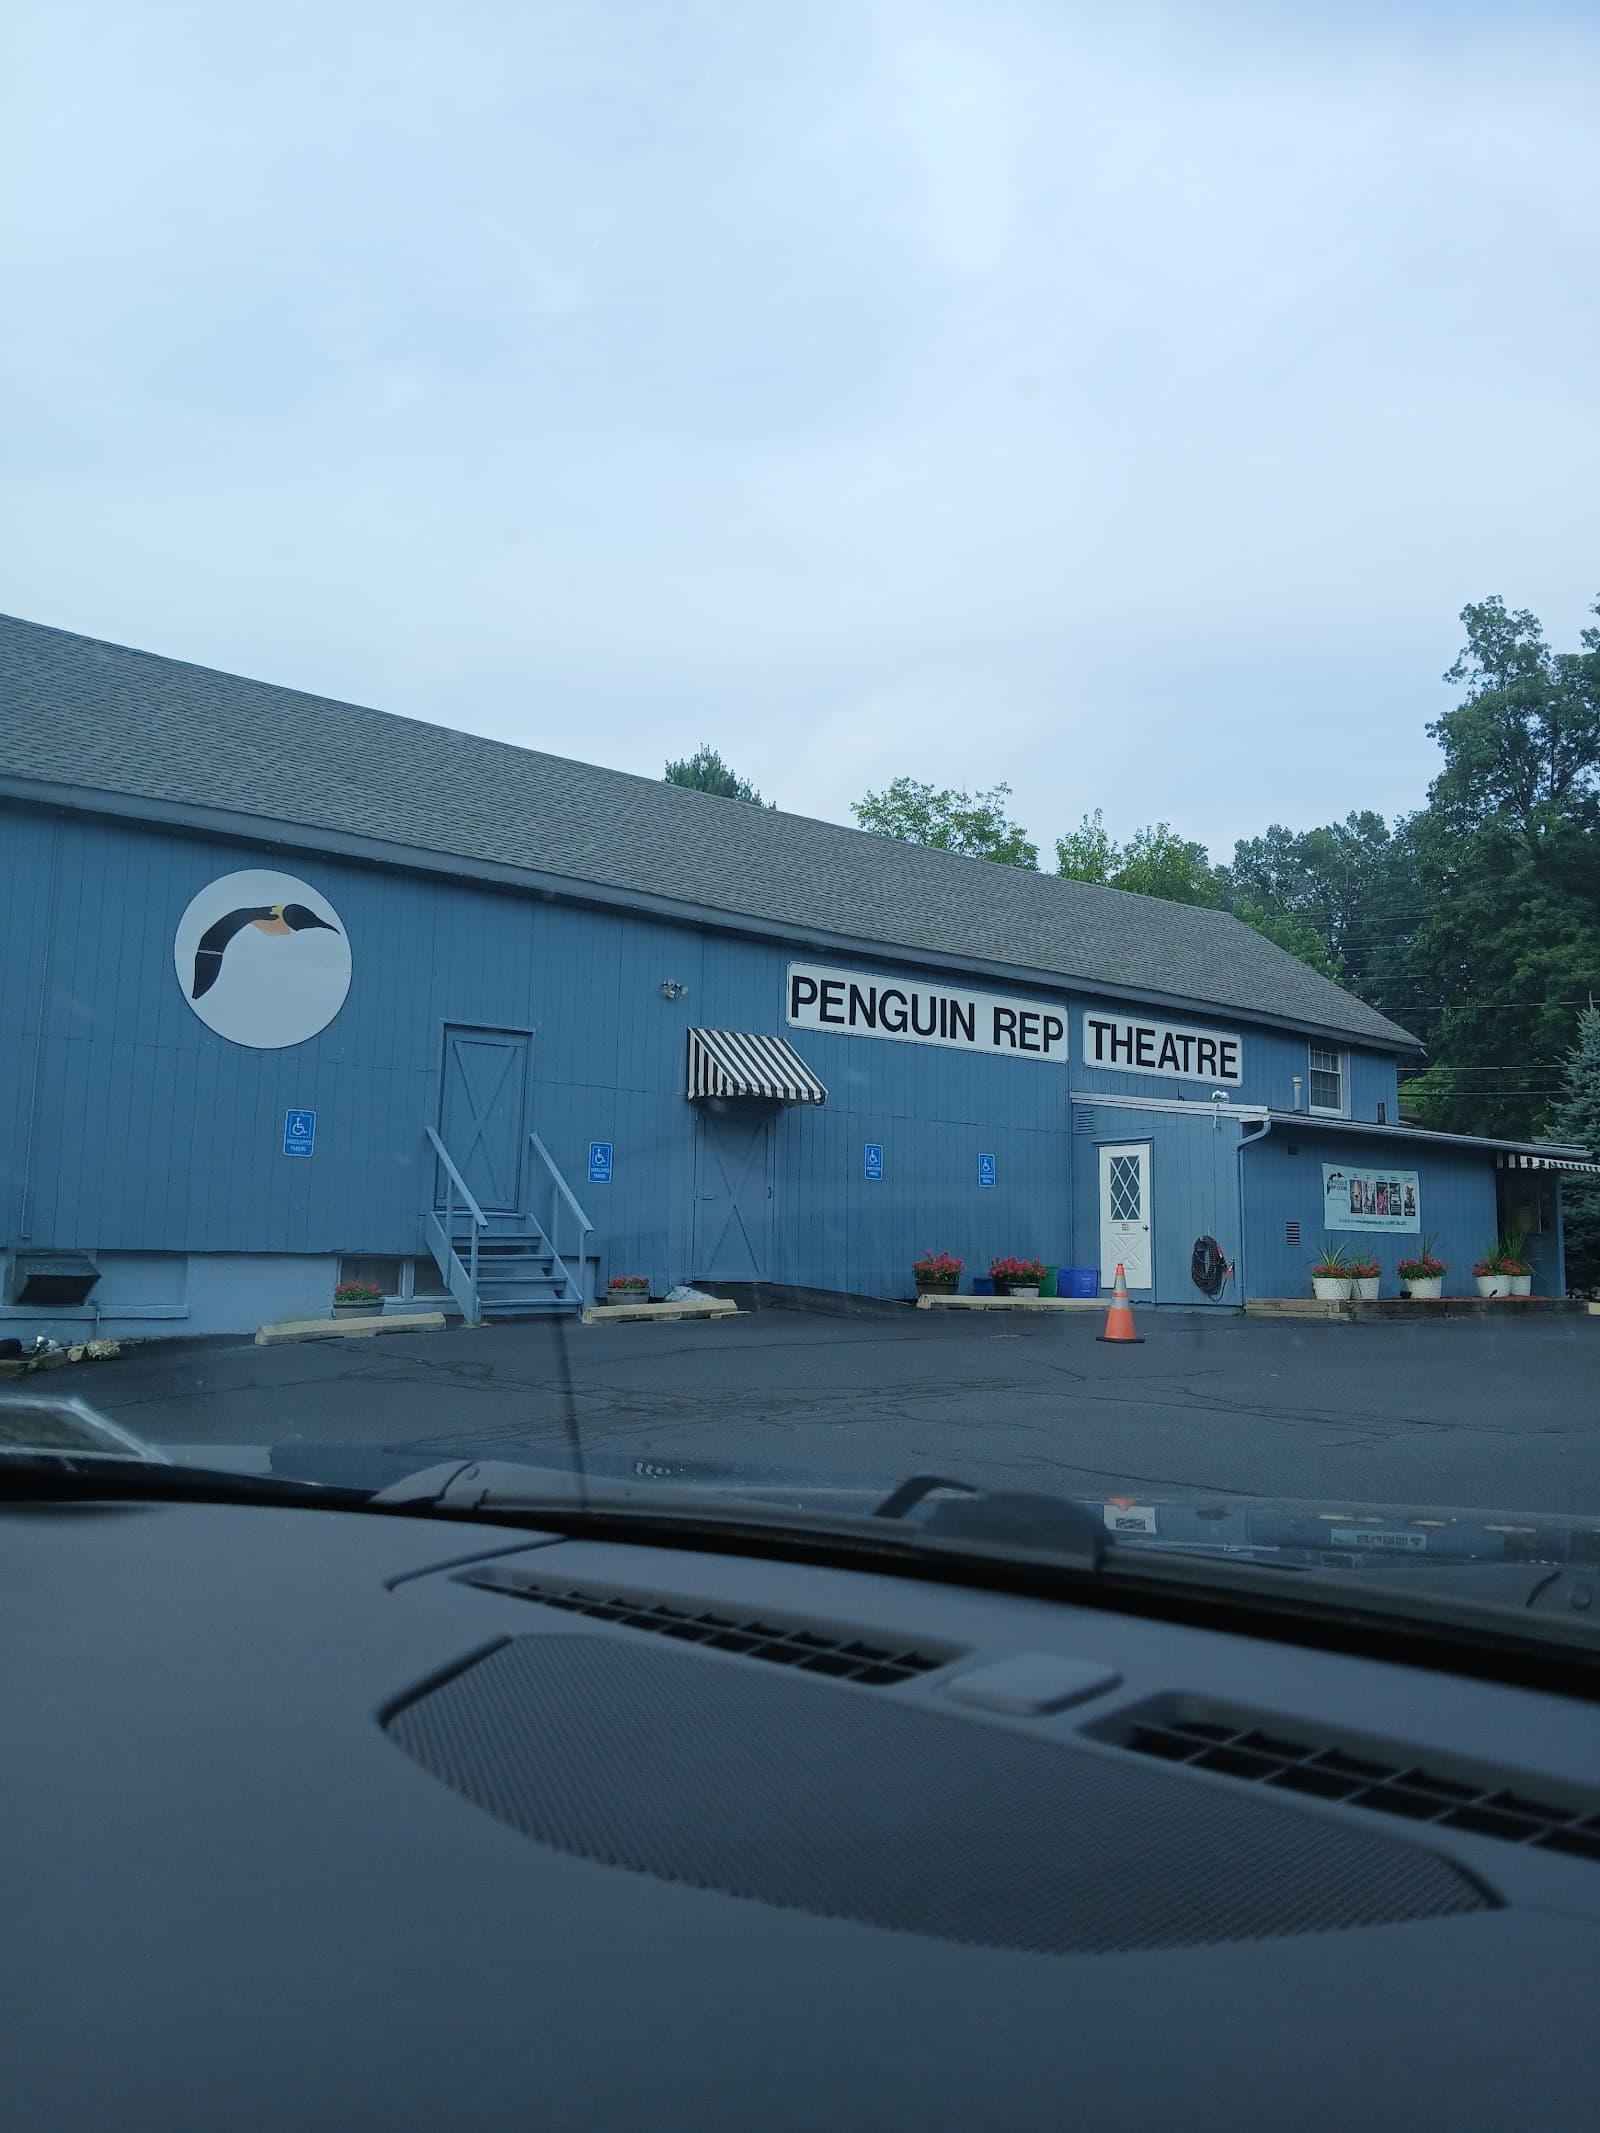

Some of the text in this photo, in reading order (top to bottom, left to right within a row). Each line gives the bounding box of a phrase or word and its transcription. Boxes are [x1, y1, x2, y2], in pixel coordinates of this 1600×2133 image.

[791, 975, 1064, 1053] PENGUIN REP
[1088, 1020, 1239, 1079] THEATRE
